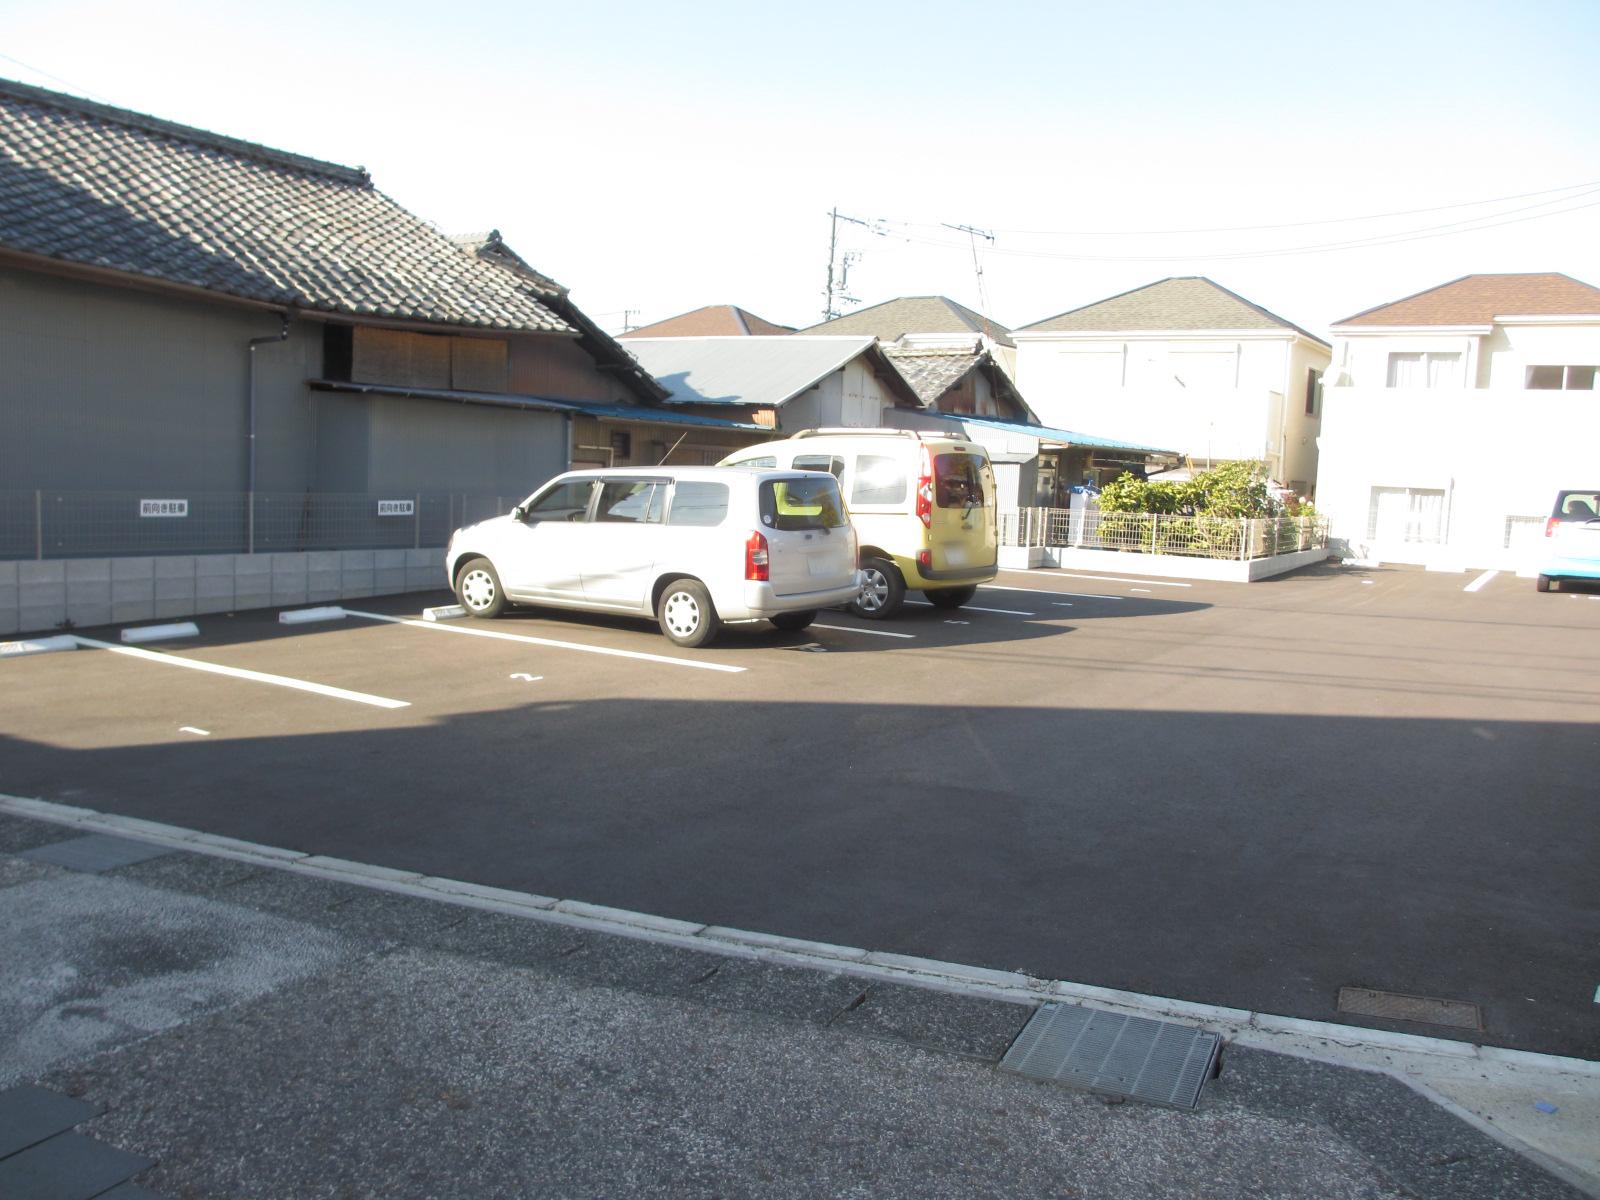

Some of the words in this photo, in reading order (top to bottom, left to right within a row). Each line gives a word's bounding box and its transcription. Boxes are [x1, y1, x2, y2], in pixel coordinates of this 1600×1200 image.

[142, 502, 186, 514] 前向き駐車
[380, 502, 412, 513] 前向き駐車
